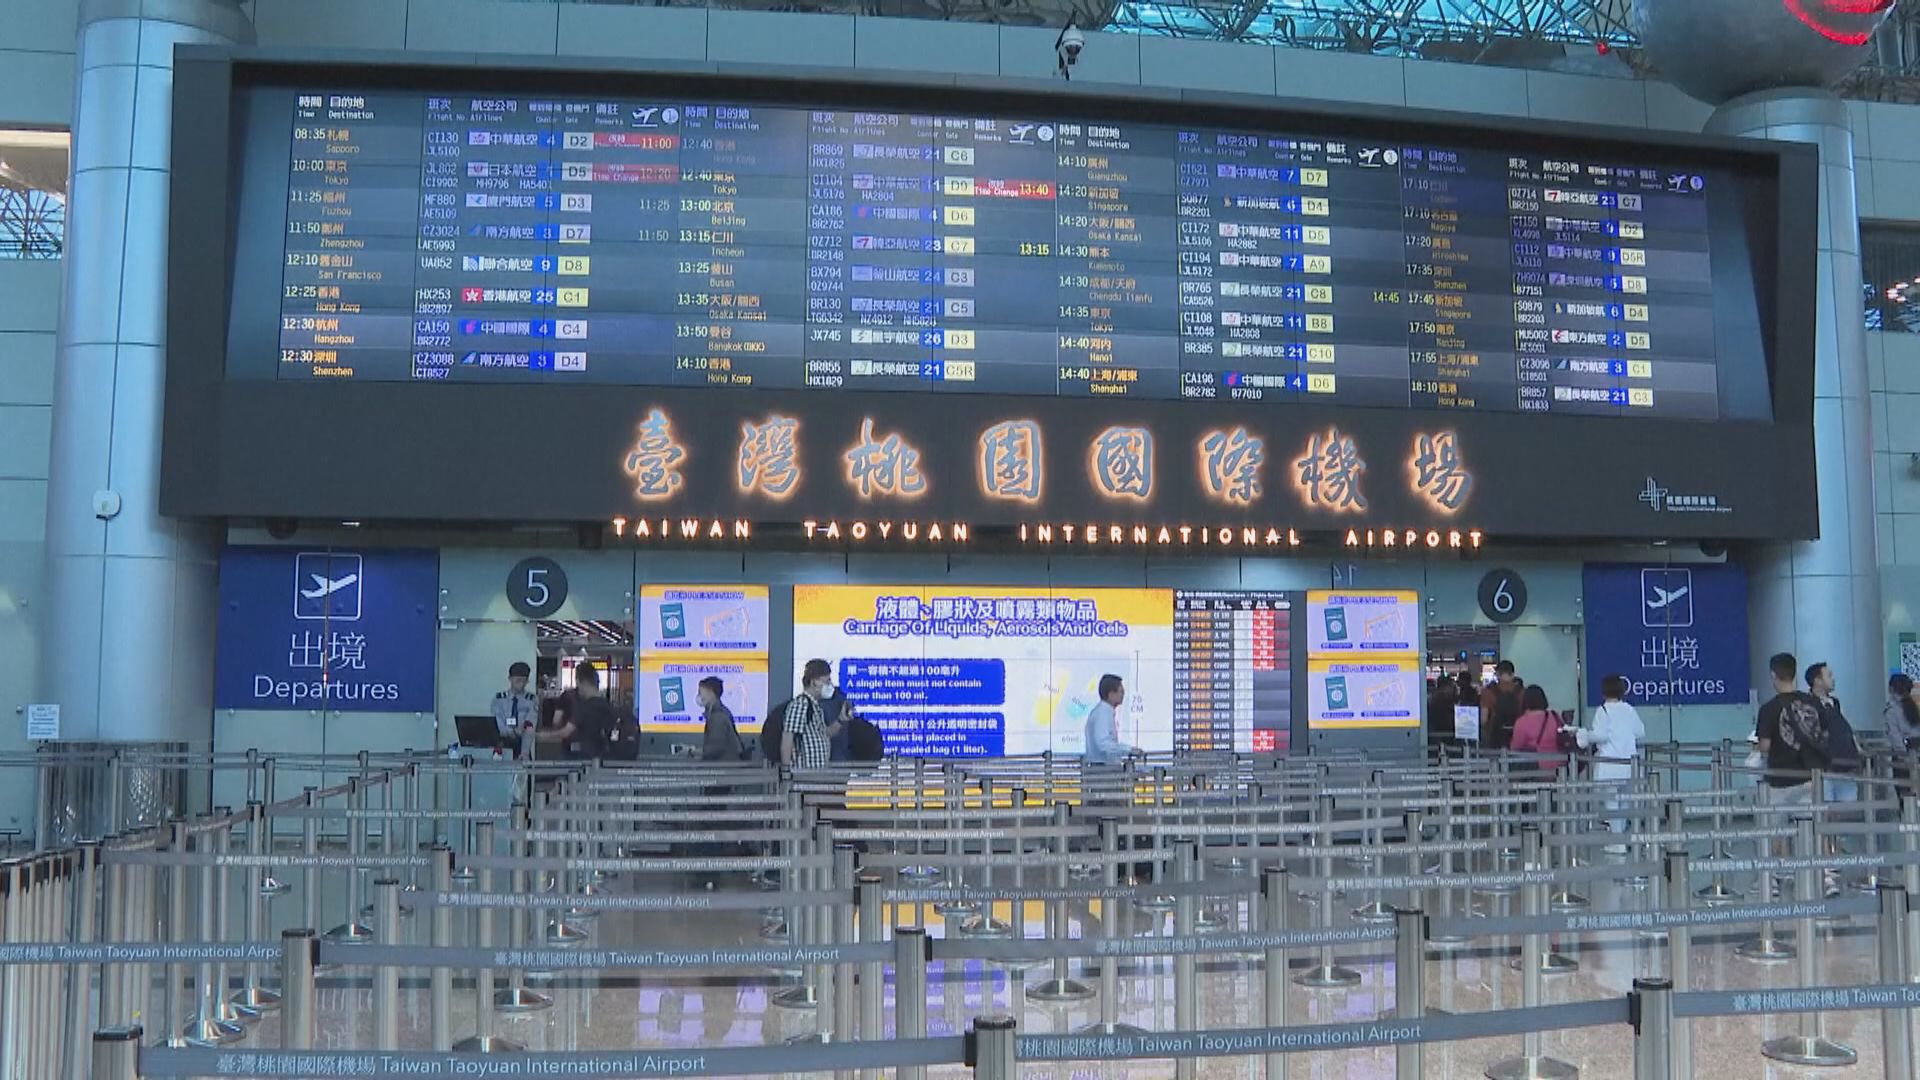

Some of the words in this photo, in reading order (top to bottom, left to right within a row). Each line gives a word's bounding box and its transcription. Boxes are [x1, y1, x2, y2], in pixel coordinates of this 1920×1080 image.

[328, 111, 374, 119] Destination
[295, 128, 326, 140] 08:35
[428, 132, 458, 143] CI130
[490, 132, 537, 145] 中華航空
[570, 136, 587, 147] D2
[641, 138, 672, 149] 11:00
[293, 160, 323, 171] 10:00
[1058, 156, 1086, 168] 14:10
[569, 166, 586, 178] D5
[1307, 172, 1321, 182] D7
[713, 186, 736, 196] Tokyo
[1020, 184, 1048, 196] 13:40
[1059, 186, 1087, 198] 14:20
[291, 191, 321, 202] 11:25
[1623, 196, 1636, 206] C7
[568, 198, 585, 208] D3
[681, 200, 710, 212] 13:00
[712, 200, 734, 213] 北京
[1308, 200, 1322, 211] D4
[712, 216, 746, 226] Beijing
[951, 210, 968, 221] D6
[1059, 216, 1087, 227] 14:20
[288, 222, 320, 233] 11:50
[567, 228, 584, 239] D7
[680, 232, 710, 242] 13:15
[1309, 230, 1324, 240] D5
[1406, 236, 1431, 247] 17:20
[1060, 246, 1088, 257] 14:30
[287, 254, 318, 266] 12:10
[422, 258, 452, 269] UA852
[565, 260, 582, 271] D8
[1310, 258, 1324, 268] A9
[679, 262, 709, 273] 13:25
[1407, 264, 1432, 275] 17:35
[951, 272, 967, 283] C3
[1060, 276, 1088, 288] 14:30
[285, 286, 316, 298] 12:25
[420, 289, 450, 300] HX253
[564, 292, 580, 303] C1
[1311, 288, 1326, 299] C8
[1373, 292, 1399, 303] 14:45
[678, 294, 708, 305] 13:35
[1409, 294, 1434, 304] 17:45
[951, 303, 968, 313] C5
[1060, 306, 1088, 317] 14:35
[1630, 308, 1643, 318] D4
[283, 318, 315, 329] 12:30
[1312, 318, 1327, 328] B8
[1409, 322, 1435, 332] 17:50
[562, 324, 580, 335] C4
[676, 326, 707, 337] 13:50
[314, 335, 354, 345] Hangzhou
[951, 334, 968, 345] D3
[1060, 337, 1090, 348] 14:40
[1631, 336, 1645, 345] D5
[282, 351, 312, 361] 12:30
[1309, 349, 1332, 359] C10
[1411, 352, 1436, 363] 17:55
[562, 356, 579, 367] D4
[676, 358, 707, 369] 14:10
[313, 367, 353, 376] Shenzhen
[946, 365, 973, 376] C5R
[1060, 368, 1090, 379] 14:40
[1633, 364, 1645, 374] C1
[1314, 378, 1330, 389] D6
[1412, 382, 1437, 393] 18:10
[626, 407, 1471, 509] 臺灣桃園國際機場
[613, 518, 749, 537] TAIWAN
[804, 522, 968, 540] TAOYUAN
[1021, 523, 1299, 546] INTERNATIONAL
[1345, 528, 1482, 548] AIRPORT
[525, 569, 549, 606] 5
[1493, 578, 1513, 613] 6
[844, 620, 907, 637] Carriage
[911, 620, 932, 635] Of
[934, 621, 993, 638] Liquids,
[996, 620, 1060, 636] Aerosols
[1061, 620, 1092, 635] And
[1094, 621, 1128, 637] Gels
[289, 630, 366, 670] 出境
[1641, 636, 1699, 670] 出境
[254, 675, 399, 704] Departures
[846, 680, 854, 688] A
[856, 679, 883, 689] single
[885, 679, 905, 687] item
[906, 680, 929, 688] must
[931, 680, 947, 688] not
[949, 679, 982, 688] contain
[847, 692, 870, 700] more
[872, 691, 892, 700] than
[895, 692, 911, 700] 100
[913, 691, 928, 700] ml.
[887, 733, 910, 742] must
[912, 733, 923, 742] be
[926, 733, 956, 743] placed
[958, 733, 966, 742] in
[901, 745, 930, 754] sealed
[932, 745, 950, 755] bag
[952, 745, 960, 755] (1
[963, 745, 988, 755] liter).
[1654, 912, 1688, 923] Taiwan
[1690, 910, 1730, 923] Taoyuan
[1732, 906, 1791, 919] International
[1793, 904, 1826, 916] Airport
[1200, 937, 1238, 949] Taiwan
[1241, 935, 1287, 948] Taoyuan
[1290, 928, 1360, 943] International
[57, 946, 101, 958] Taiwan
[105, 946, 160, 961] Taoyuan
[163, 945, 244, 958] International
[247, 946, 282, 961] Airpo
[609, 951, 653, 964] Taiwan
[655, 951, 709, 967] Taoyuan
[712, 949, 792, 963] International
[794, 949, 840, 964] Airport
[1851, 988, 1898, 1003] Taiwan
[1137, 1036, 1192, 1052] Taiwan
[1196, 1033, 1263, 1053] Taoyuan
[1267, 1027, 1365, 1048] International
[1368, 1025, 1422, 1045] Airport
[380, 1056, 442, 1074] Taiwan
[446, 1057, 521, 1078] Taoyuan
[526, 1056, 638, 1074] International
[642, 1055, 706, 1076] Airport
